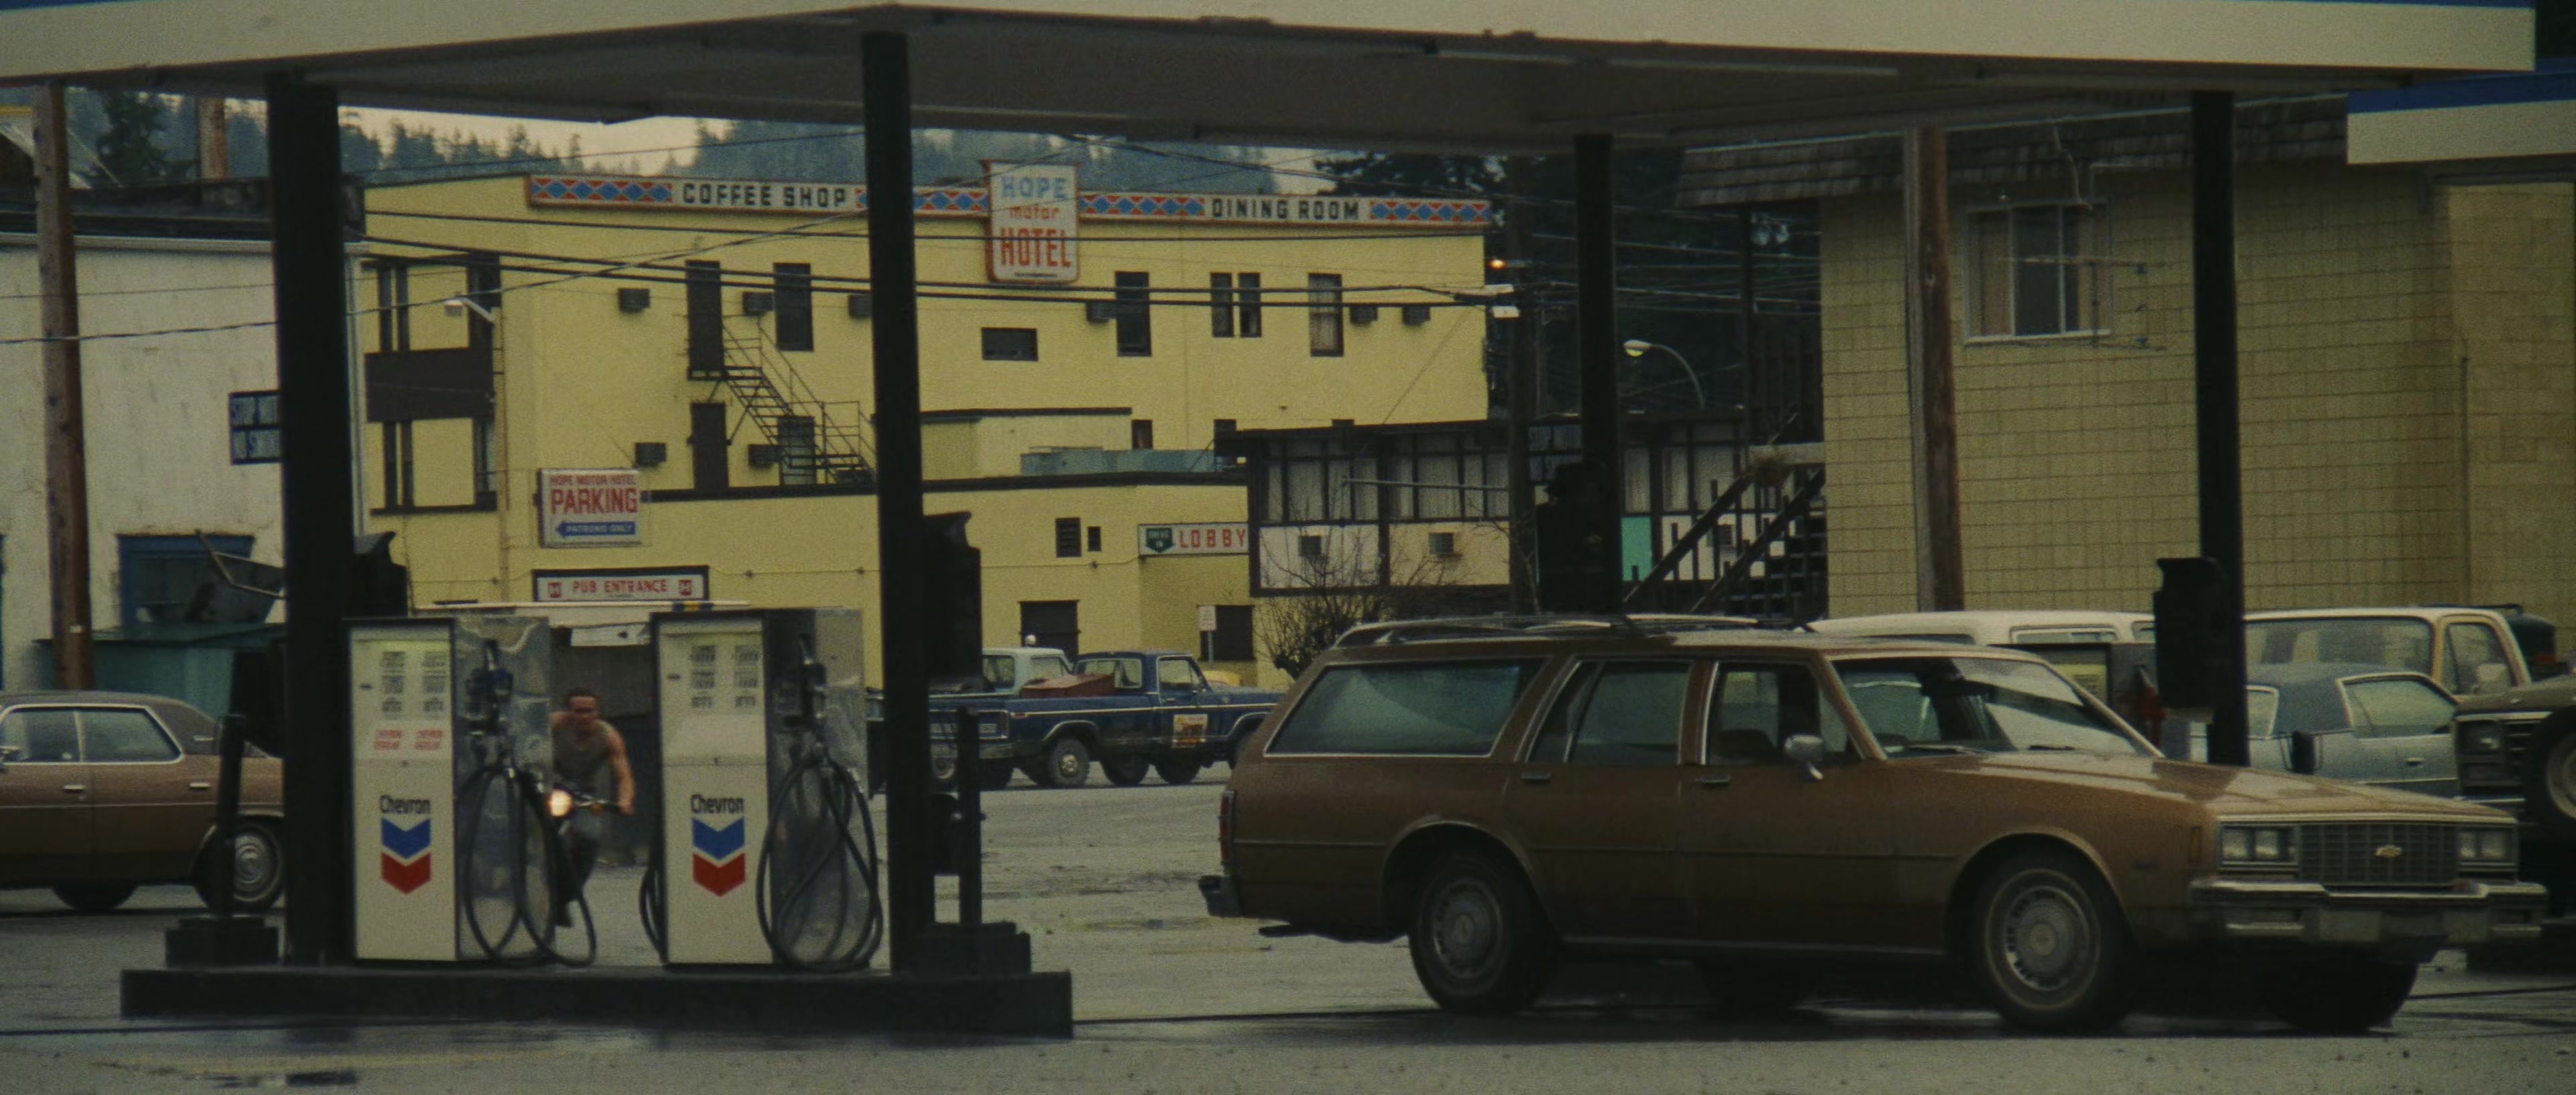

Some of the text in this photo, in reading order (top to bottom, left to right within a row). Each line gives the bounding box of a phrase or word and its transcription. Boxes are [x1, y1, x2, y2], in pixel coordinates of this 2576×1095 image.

[683, 183, 847, 208] COFFEE SHOP
[1001, 176, 1067, 199] HOPE
[1212, 198, 1359, 220] DINING ROOM
[1001, 227, 1071, 267] HOTEL
[551, 488, 638, 514] PARKING
[1179, 529, 1246, 549] LOBBY
[572, 580, 597, 593] PUB
[604, 579, 666, 593] ENTRANCE
[379, 794, 431, 815] Chevron
[690, 794, 745, 815] Chevron
